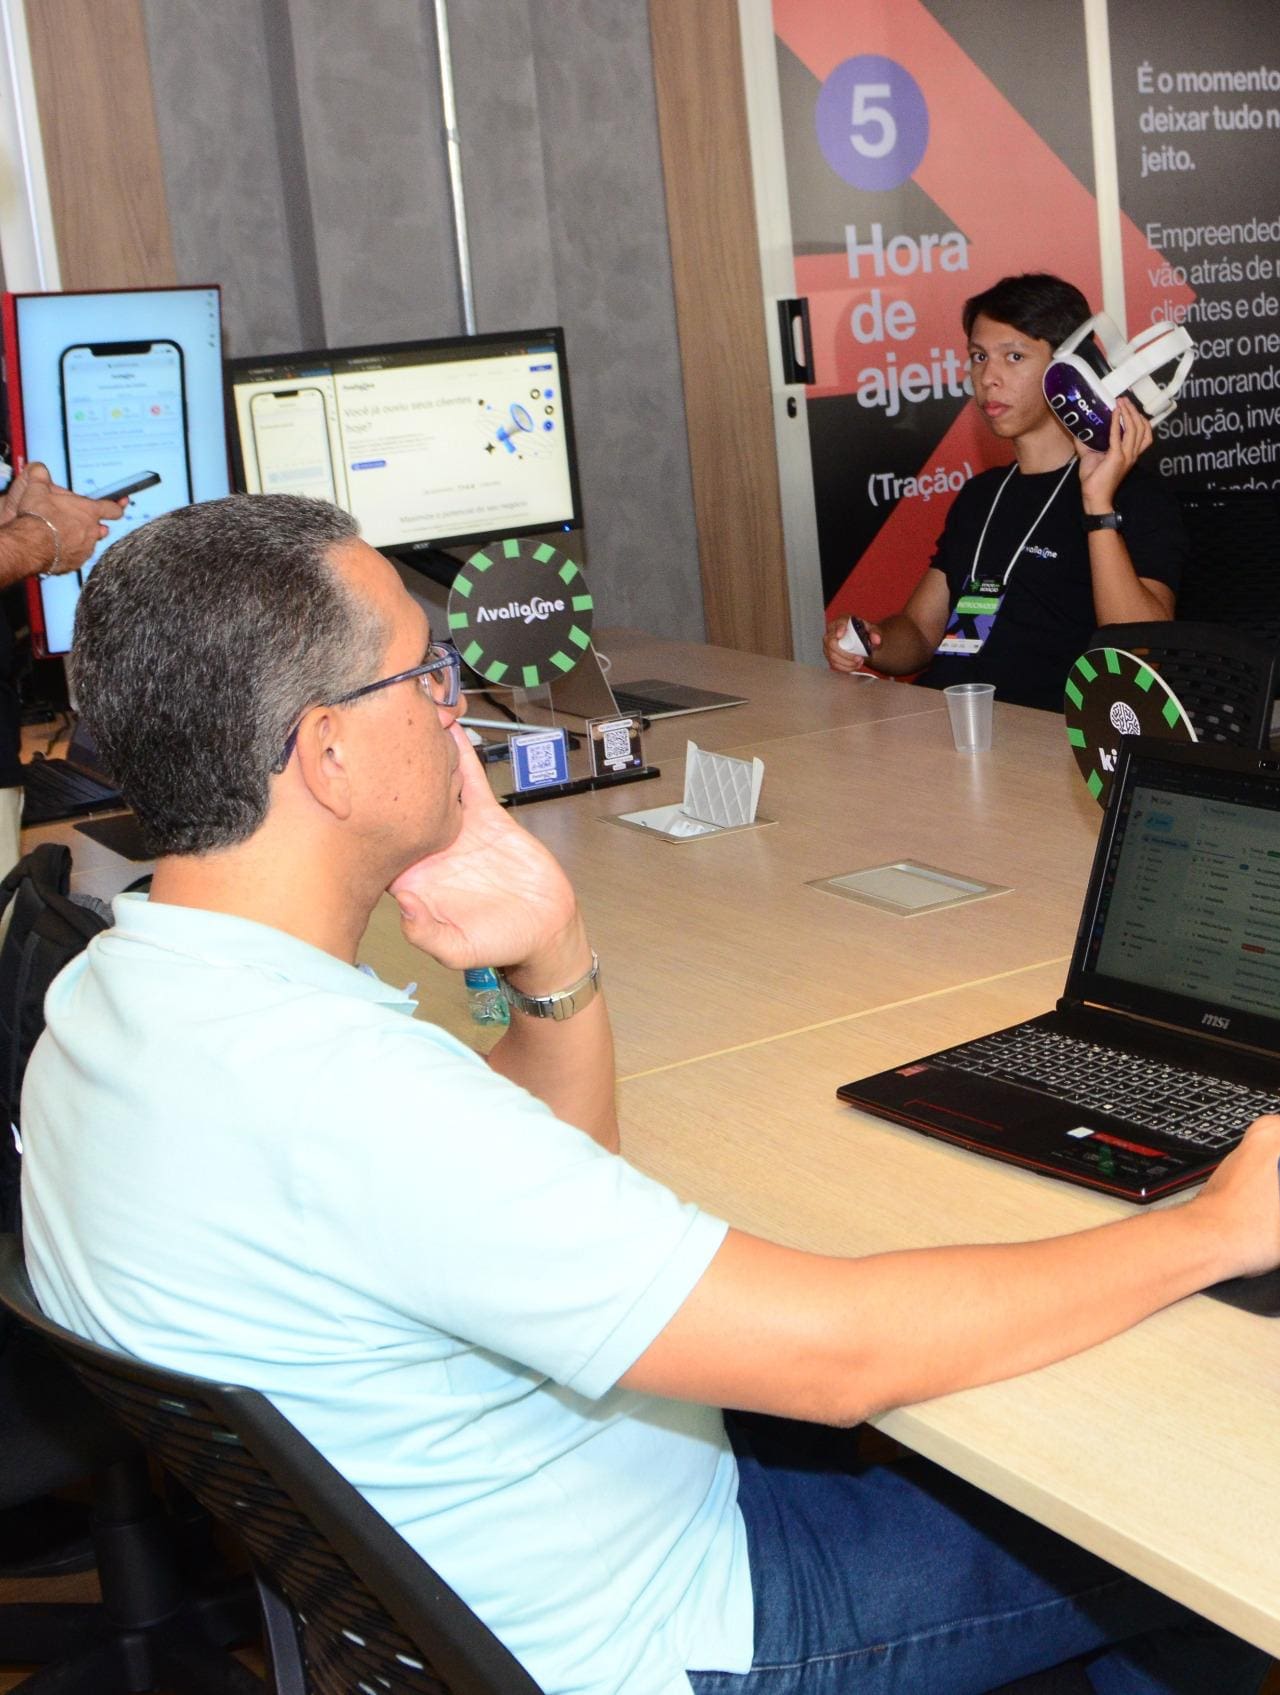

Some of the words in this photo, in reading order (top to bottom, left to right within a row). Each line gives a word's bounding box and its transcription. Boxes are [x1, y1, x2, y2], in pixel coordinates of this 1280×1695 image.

[1137, 61, 1154, 93] É
[1157, 72, 1173, 93] o
[850, 83, 897, 159] 5
[1139, 105, 1210, 133] deixar
[1212, 103, 1263, 130] tudo
[1140, 145, 1196, 178] jeito.
[845, 222, 970, 279] Hora
[1147, 262, 1187, 288] vão
[1190, 256, 1243, 286] atrás
[1246, 254, 1272, 280] de
[851, 288, 917, 344] de
[1151, 297, 1233, 325] clientes
[1235, 299, 1249, 318] e
[1252, 291, 1279, 317] de
[1237, 336, 1250, 356] o
[1157, 408, 1244, 440] solução,
[1159, 457, 1193, 477] em
